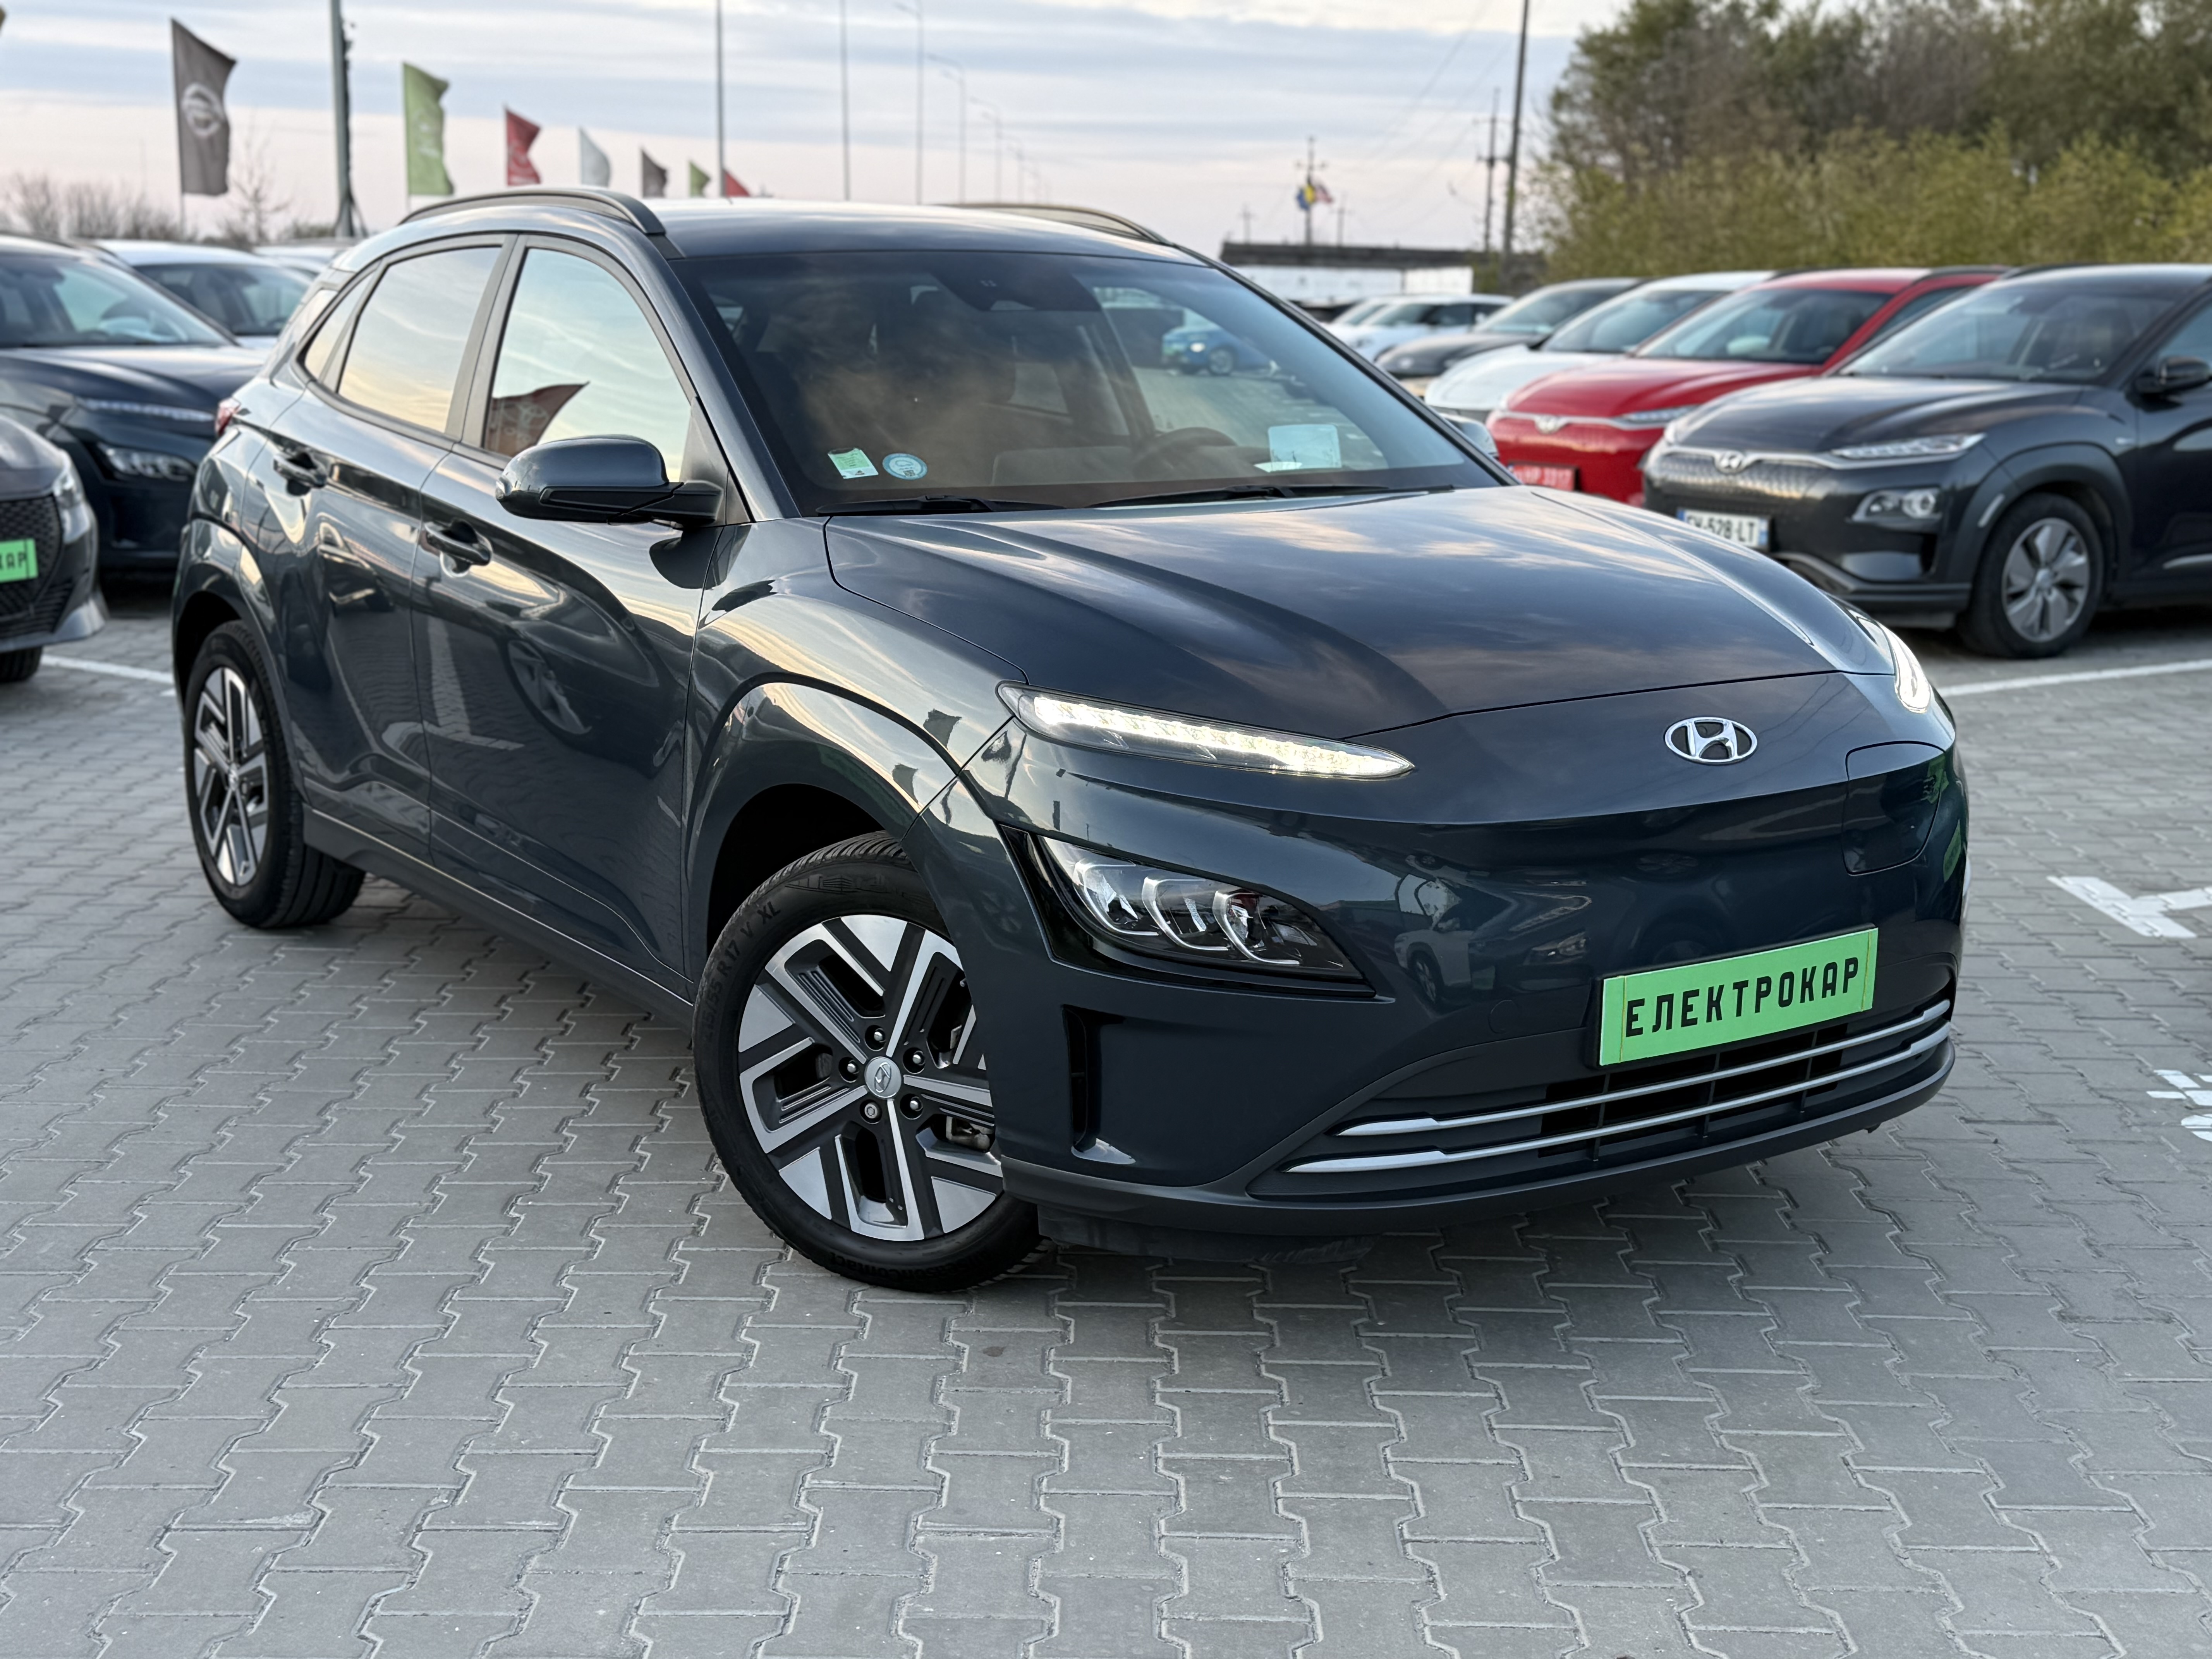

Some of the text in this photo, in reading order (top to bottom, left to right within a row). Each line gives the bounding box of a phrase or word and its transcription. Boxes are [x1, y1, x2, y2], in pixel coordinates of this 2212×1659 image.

[740, 921, 754, 938] V
[757, 901, 781, 925] XL
[1625, 957, 1859, 1038] ЕЛЕКТРОКАР
